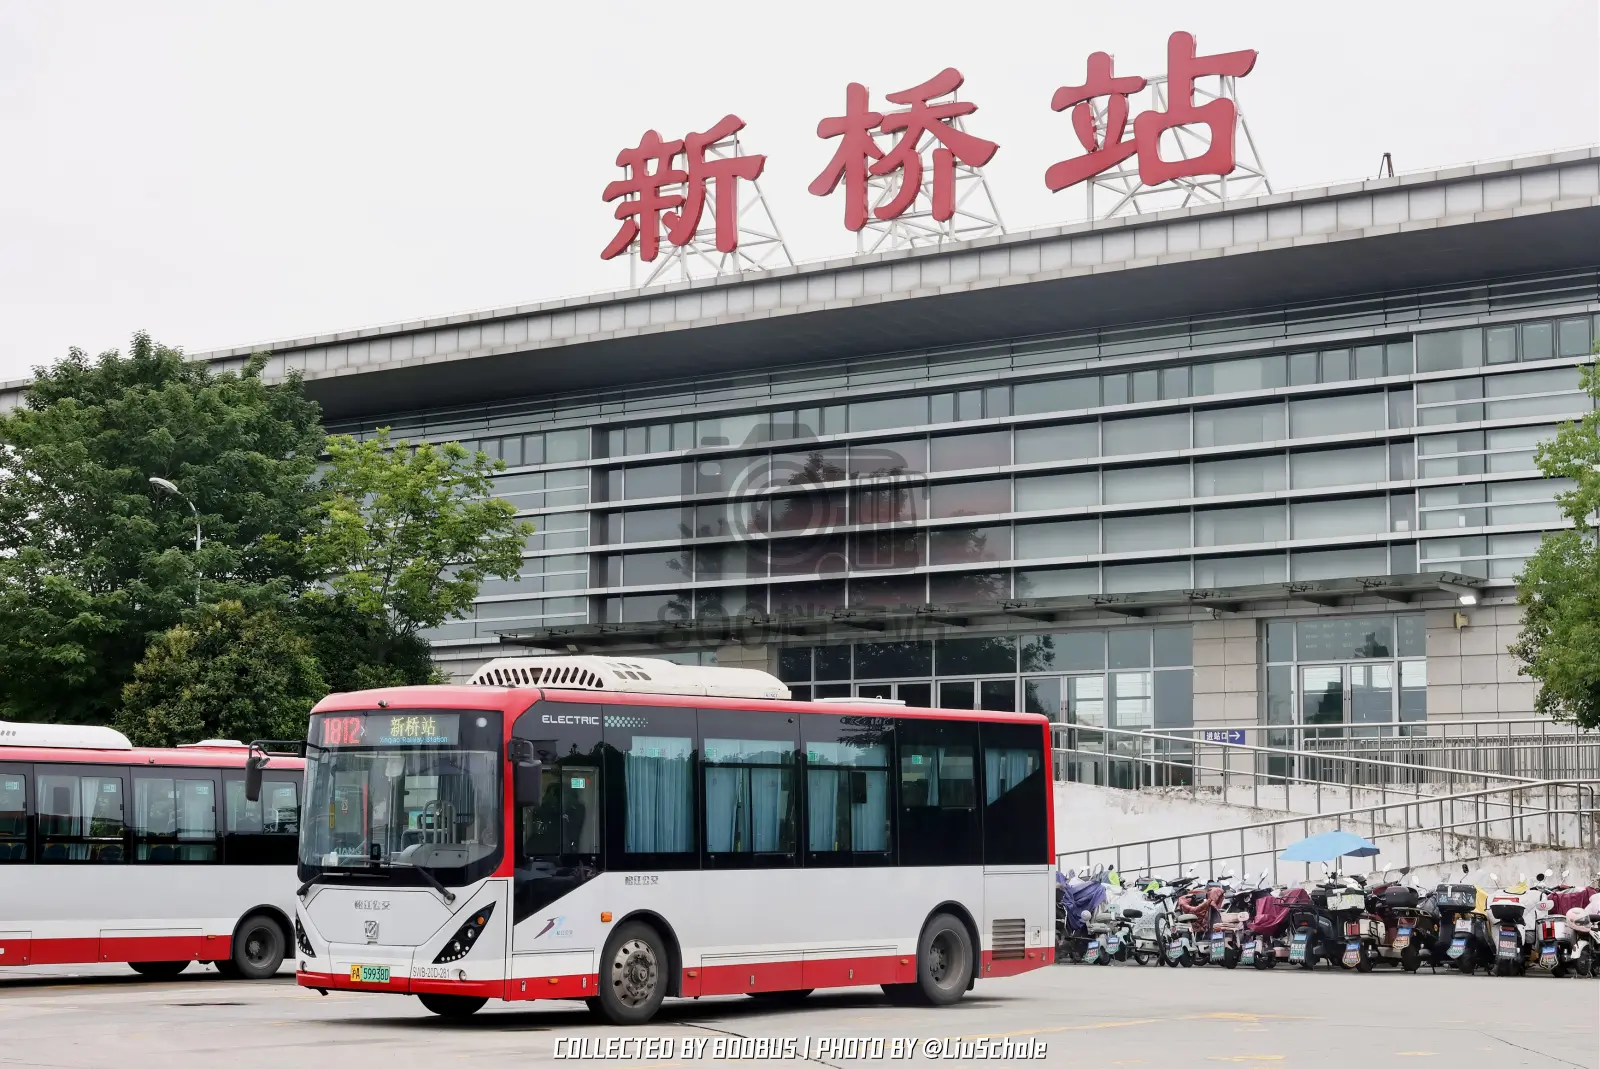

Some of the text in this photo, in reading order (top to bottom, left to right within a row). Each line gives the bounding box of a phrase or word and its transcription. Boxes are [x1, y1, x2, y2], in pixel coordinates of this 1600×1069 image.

[601, 30, 1259, 262] 新桥站
[390, 716, 436, 737] 新桥站
[541, 714, 600, 725] ELECTRIC
[323, 717, 361, 744] 1812
[1206, 731, 1228, 741] 进站口
[354, 900, 391, 910] 松江公交
